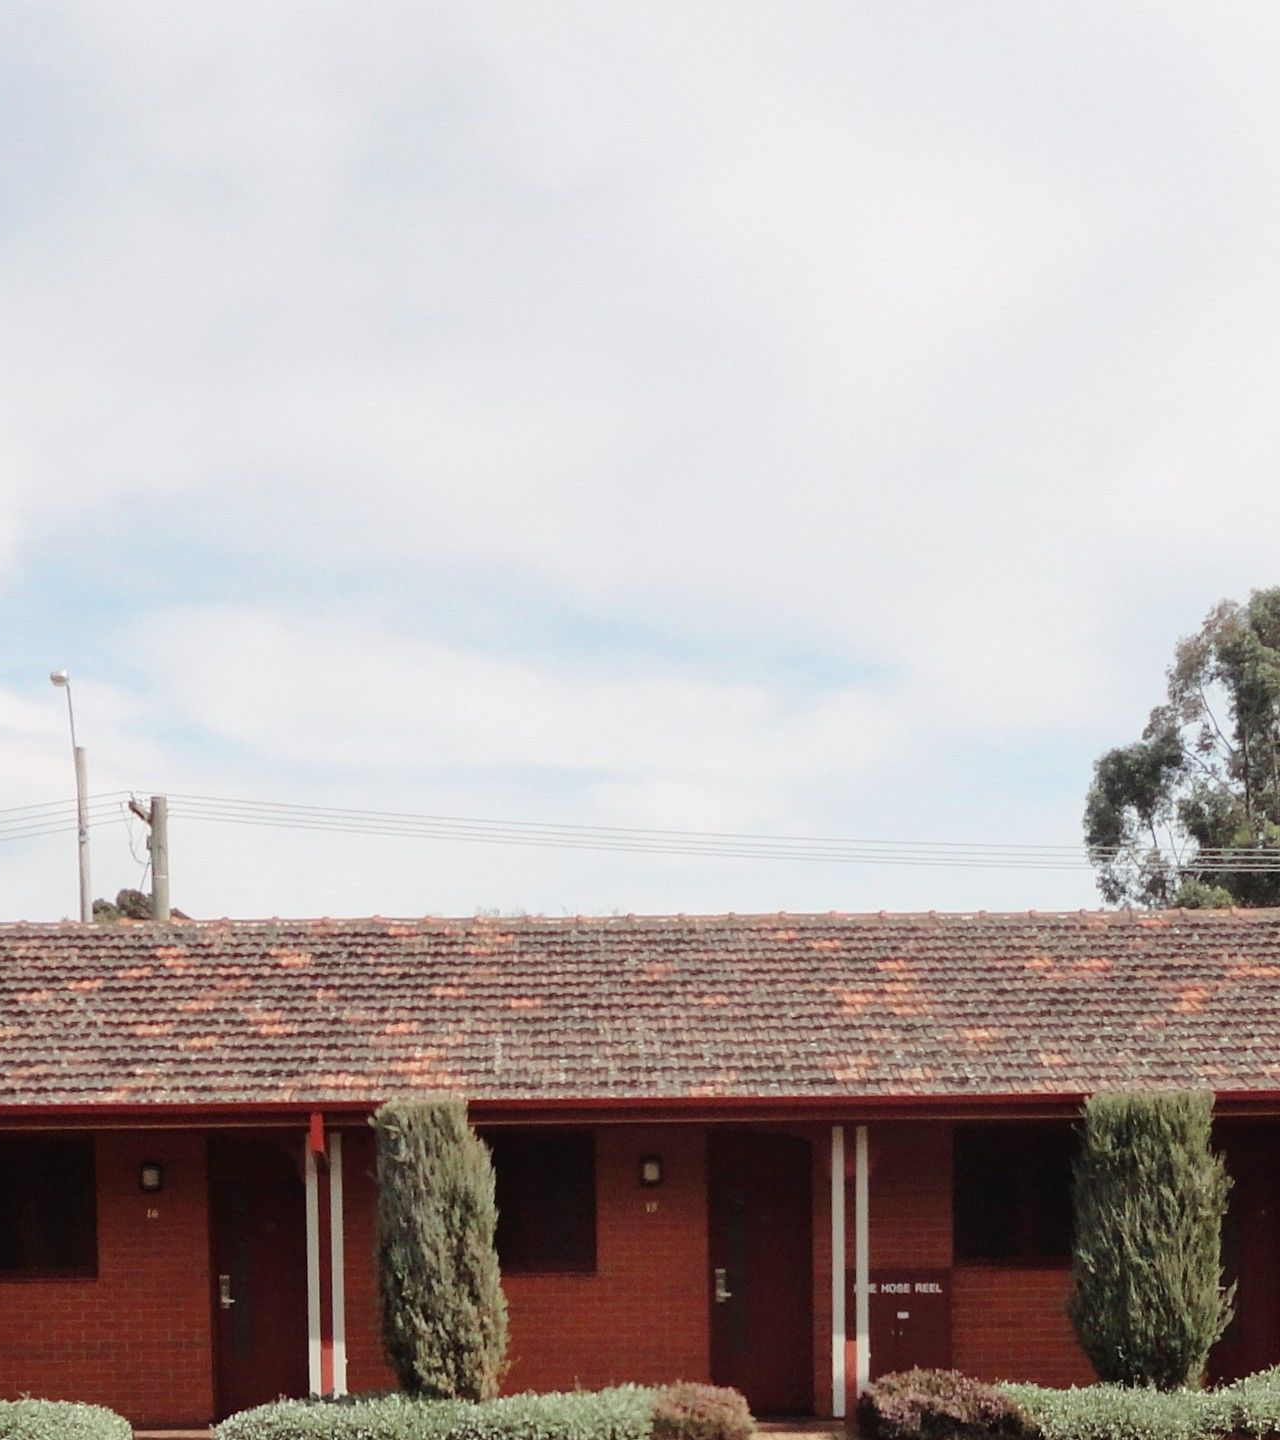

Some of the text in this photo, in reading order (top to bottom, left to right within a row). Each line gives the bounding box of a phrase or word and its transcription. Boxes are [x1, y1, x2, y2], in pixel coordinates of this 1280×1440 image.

[147, 1208, 159, 1219] 16
[880, 1283, 910, 1294] HOSE
[914, 1282, 942, 1293] REEL
